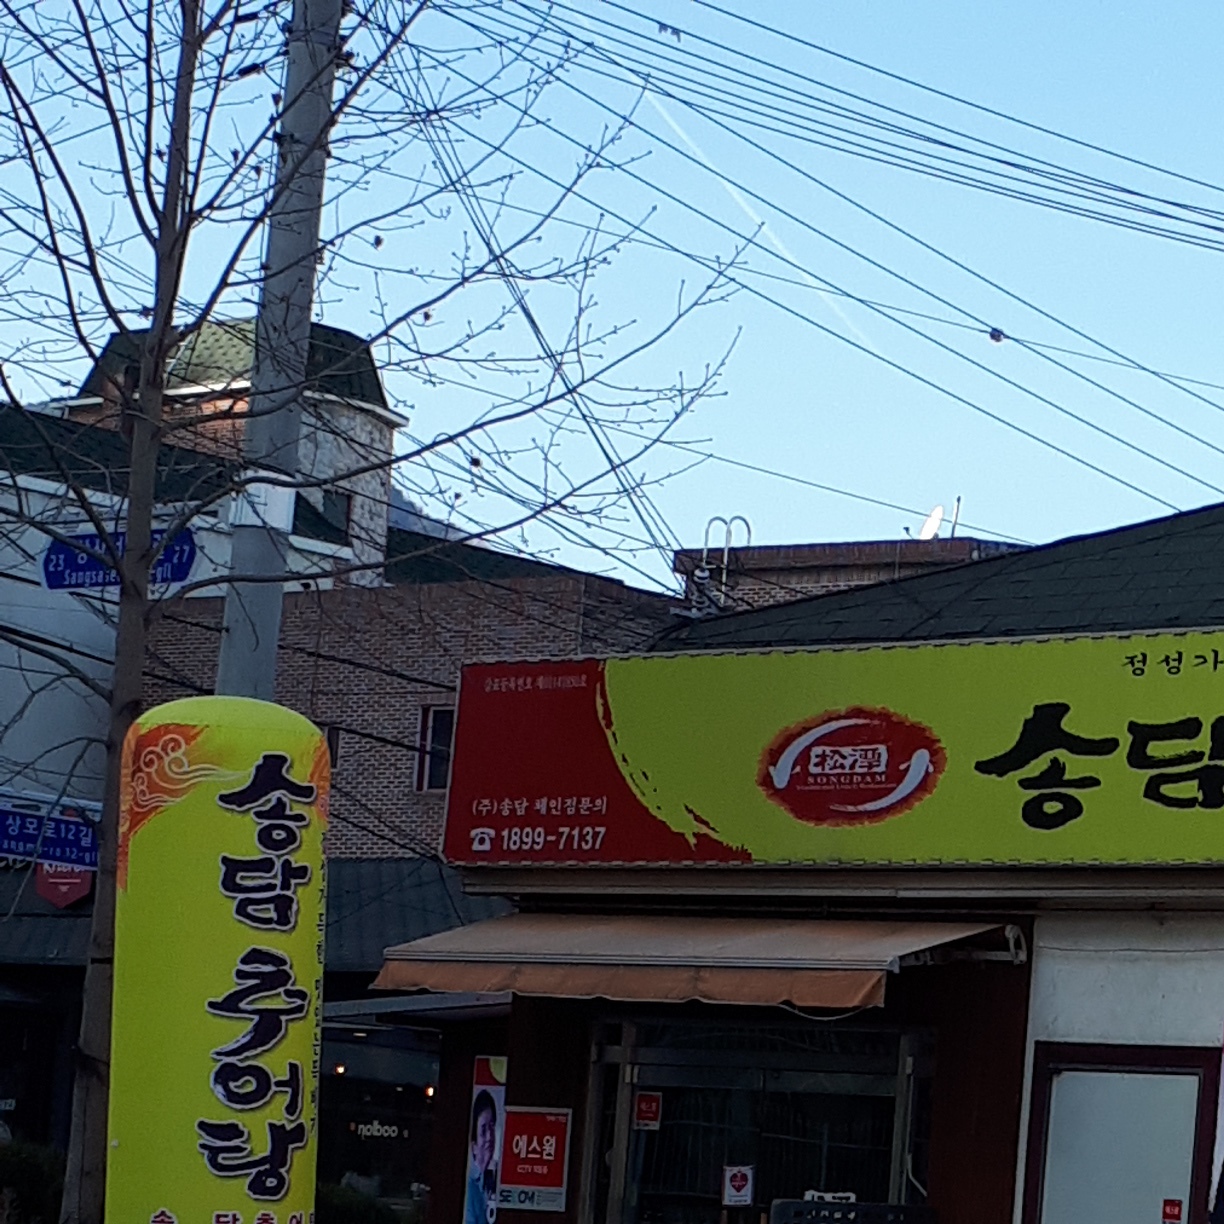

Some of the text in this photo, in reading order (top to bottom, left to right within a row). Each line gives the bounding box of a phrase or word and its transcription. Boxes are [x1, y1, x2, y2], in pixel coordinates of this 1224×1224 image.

[49, 553, 65, 571] 23
[807, 774, 887, 785] SONGDAM
[472, 796, 530, 817] (주)송담
[5, 814, 94, 848] 상모로12길
[500, 825, 607, 851] 1899-7137
[512, 1134, 557, 1161] 에스원
